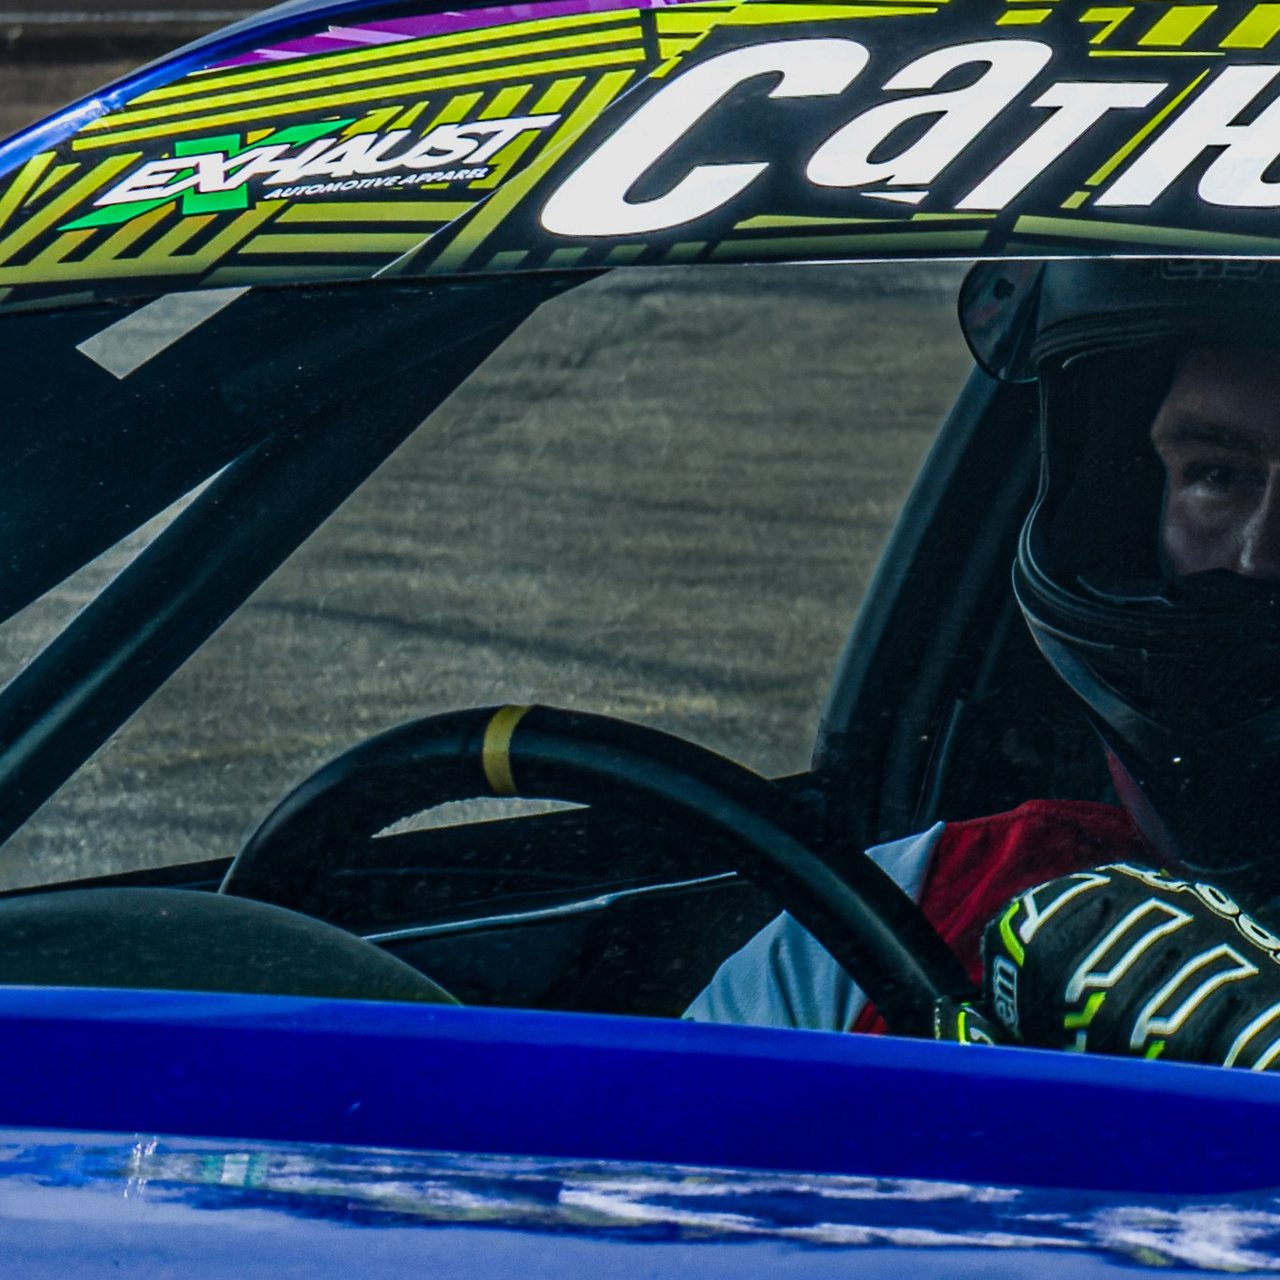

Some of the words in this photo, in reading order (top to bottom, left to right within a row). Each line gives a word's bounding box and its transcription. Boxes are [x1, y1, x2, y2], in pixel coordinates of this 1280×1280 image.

[94, 114, 561, 206] EXHAUST
[263, 175, 403, 199] AUTOMOTIVE
[400, 167, 490, 184] APPAREL
